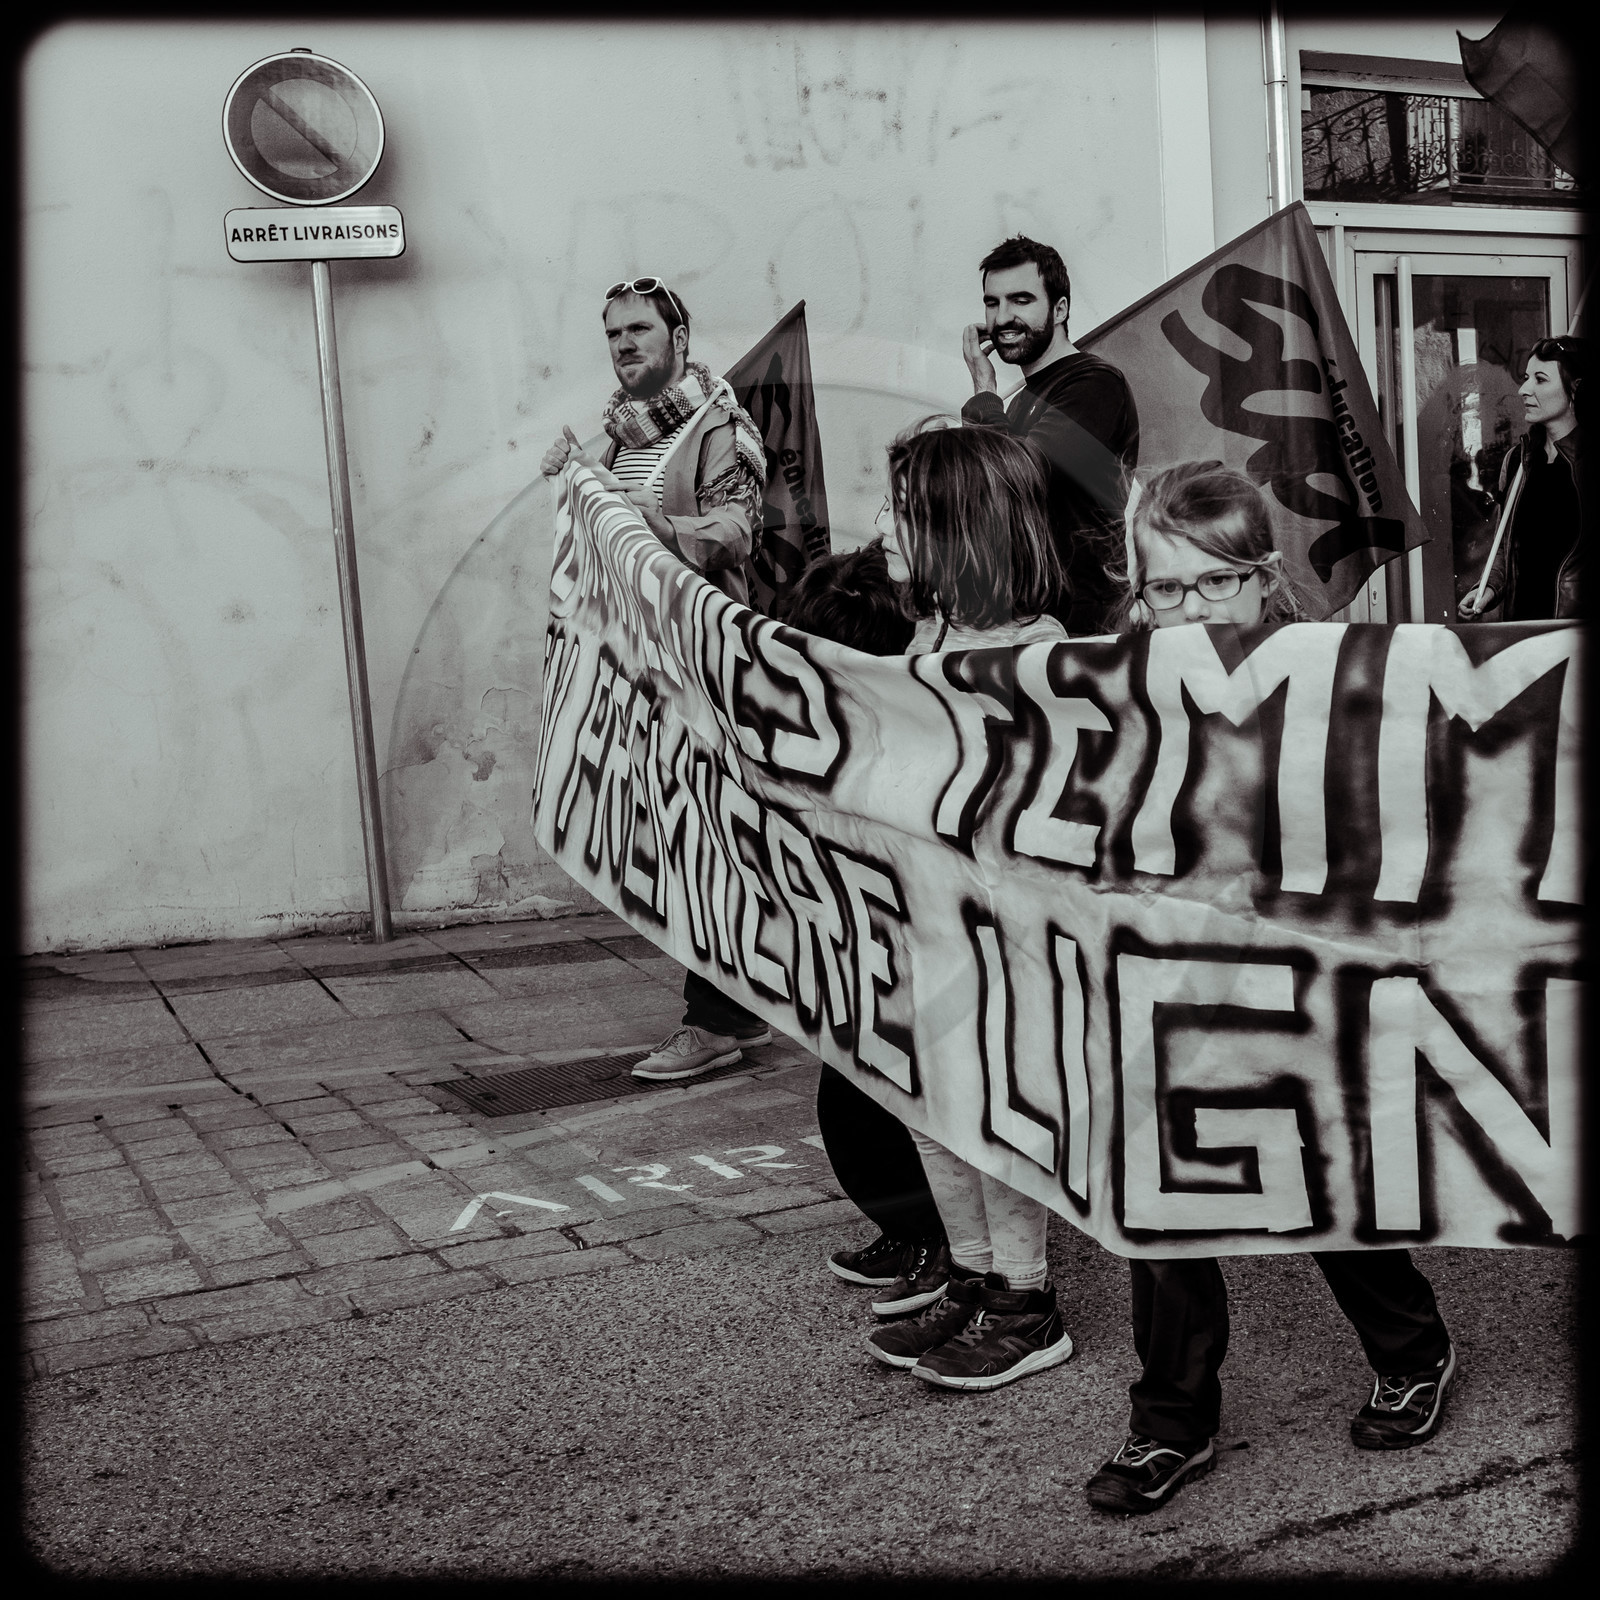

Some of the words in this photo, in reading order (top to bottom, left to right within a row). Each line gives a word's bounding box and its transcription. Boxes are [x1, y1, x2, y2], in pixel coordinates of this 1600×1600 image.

[231, 223, 289, 243] ARRÊT
[293, 223, 400, 241] LIVRAISONS
[448, 1133, 828, 1233] ARR
